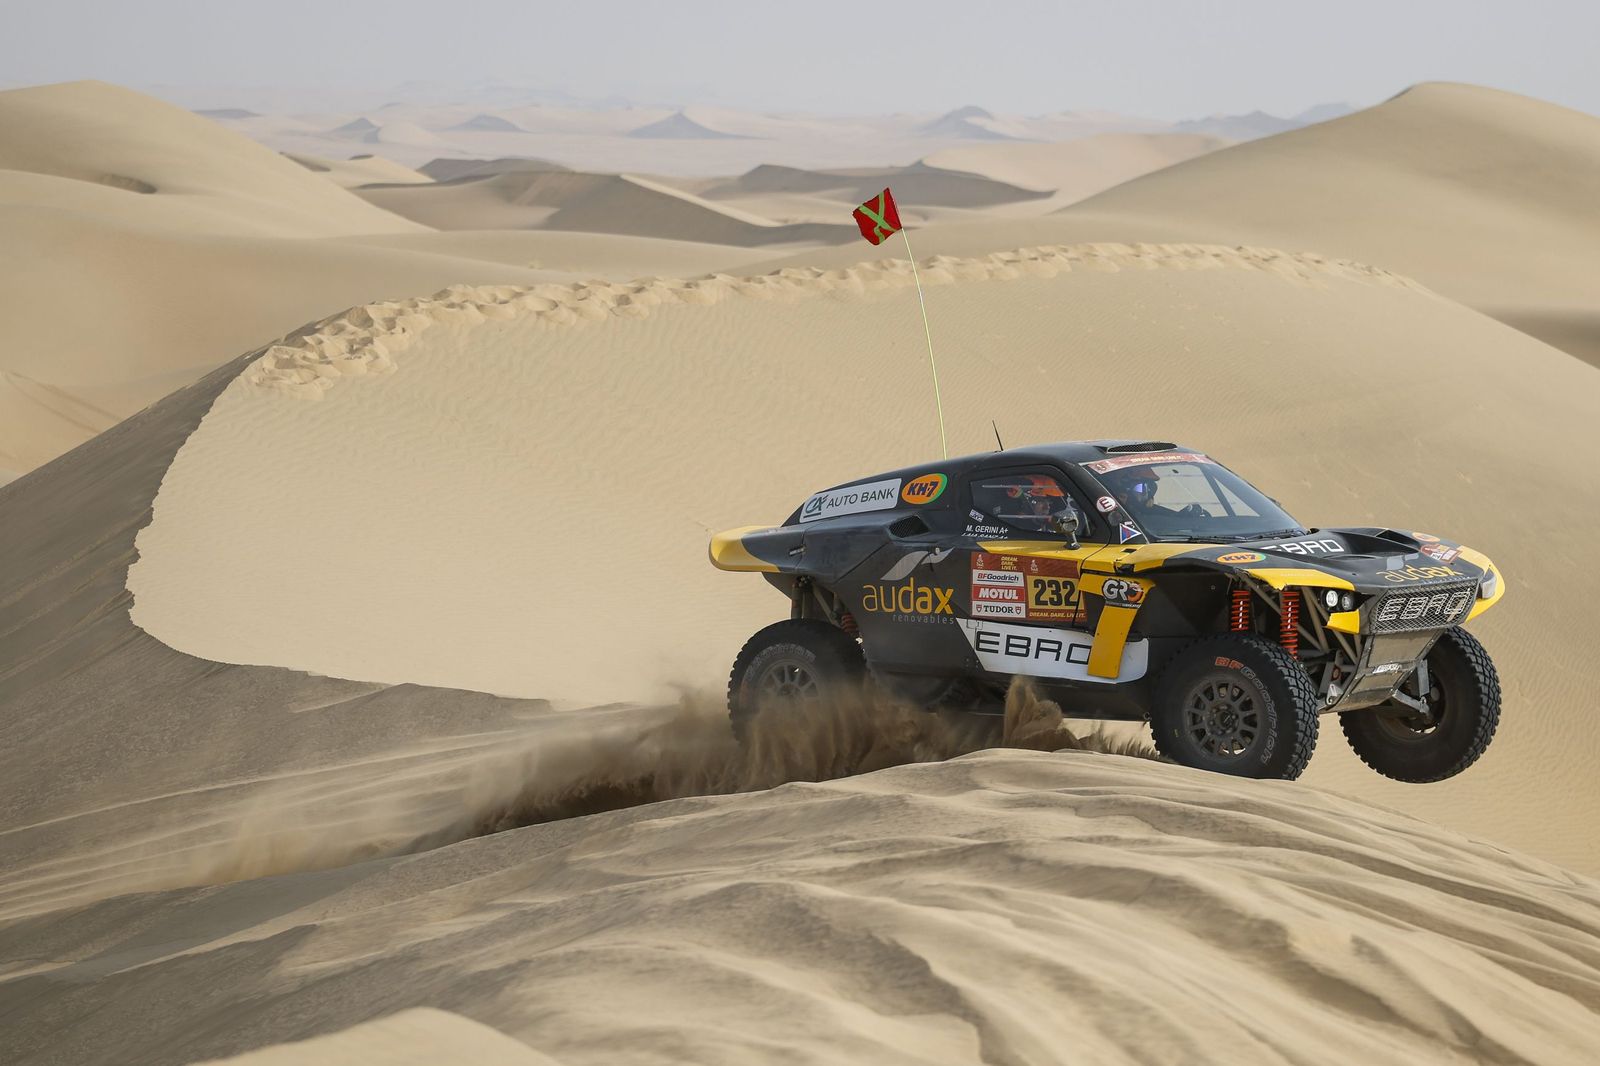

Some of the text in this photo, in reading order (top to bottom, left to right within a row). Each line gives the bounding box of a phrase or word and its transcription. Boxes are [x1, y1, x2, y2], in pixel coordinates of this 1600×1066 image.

[826, 493, 858, 509] AUTO
[860, 487, 895, 503] BANK
[975, 525, 999, 534] GERINI
[977, 572, 1019, 581] BFGoodrich
[1376, 564, 1464, 582] audax
[863, 577, 954, 614] audax
[978, 587, 1019, 600] MOTUL
[1034, 578, 1079, 607] 232
[983, 605, 1014, 614] TUDOR
[1378, 592, 1470, 621] EBRO
[893, 614, 954, 625] renovables
